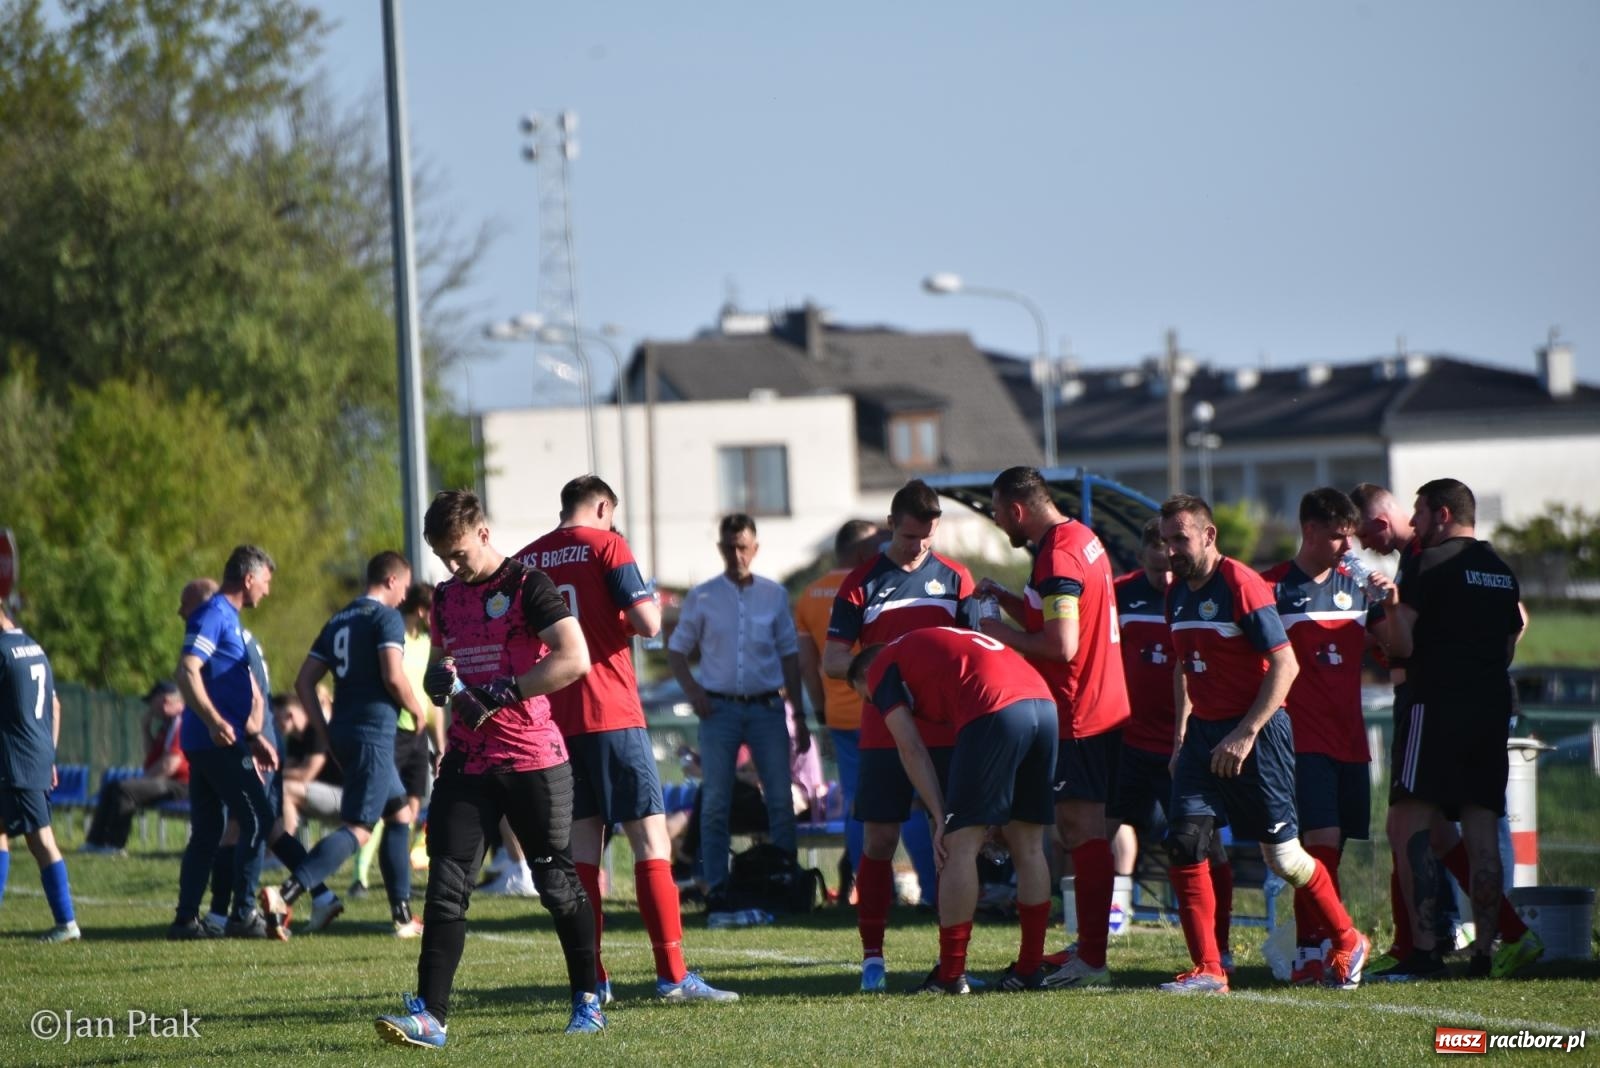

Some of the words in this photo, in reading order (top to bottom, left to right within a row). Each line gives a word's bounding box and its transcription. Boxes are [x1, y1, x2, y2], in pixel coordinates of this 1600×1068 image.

[541, 545, 590, 568] BRZEZIE
[1465, 569, 1481, 585] LKS
[334, 626, 350, 678] 9
[30, 663, 46, 720] 7
